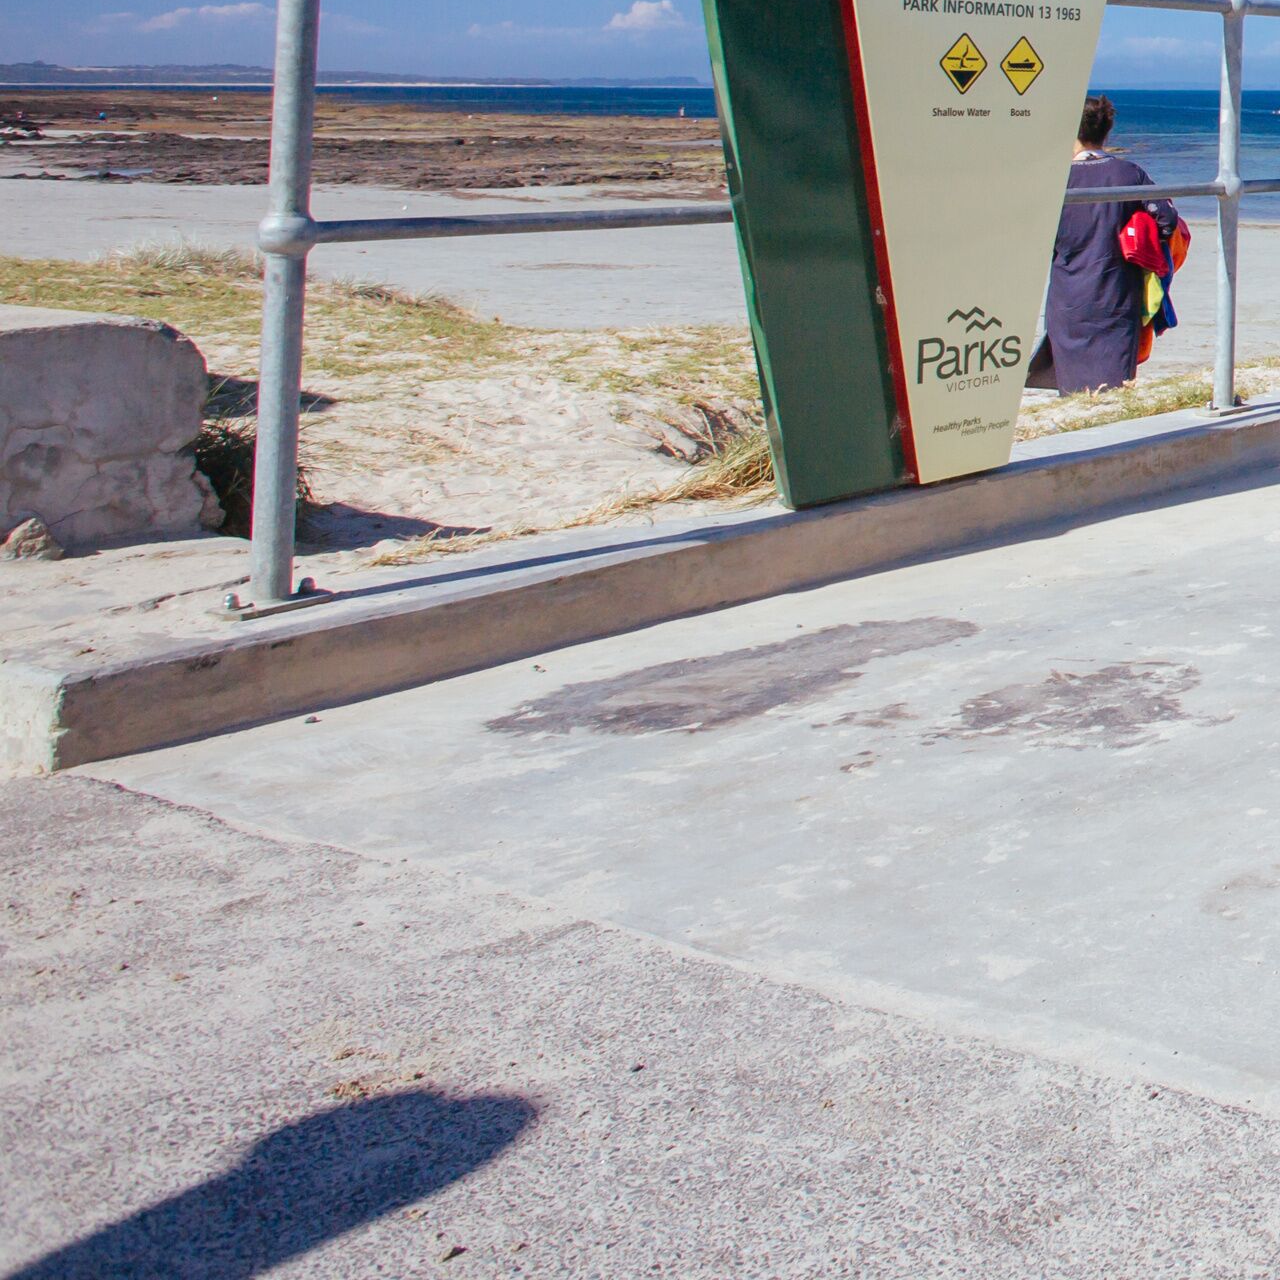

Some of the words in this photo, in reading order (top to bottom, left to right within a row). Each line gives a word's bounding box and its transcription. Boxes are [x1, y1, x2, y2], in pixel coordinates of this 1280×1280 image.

[943, 0, 1034, 18] INFORMATION
[1038, 6, 1052, 19] 13
[1055, 7, 1081, 21] 1963
[932, 108, 965, 117] Shallow
[967, 108, 991, 117] Water
[1010, 108, 1031, 117] Boats
[917, 335, 1021, 385] Parks
[946, 374, 1000, 393] VICTORIA
[933, 420, 962, 434] Healthy
[962, 417, 982, 428] Parks
[960, 425, 989, 437] Healthy
[987, 419, 1010, 431] People
